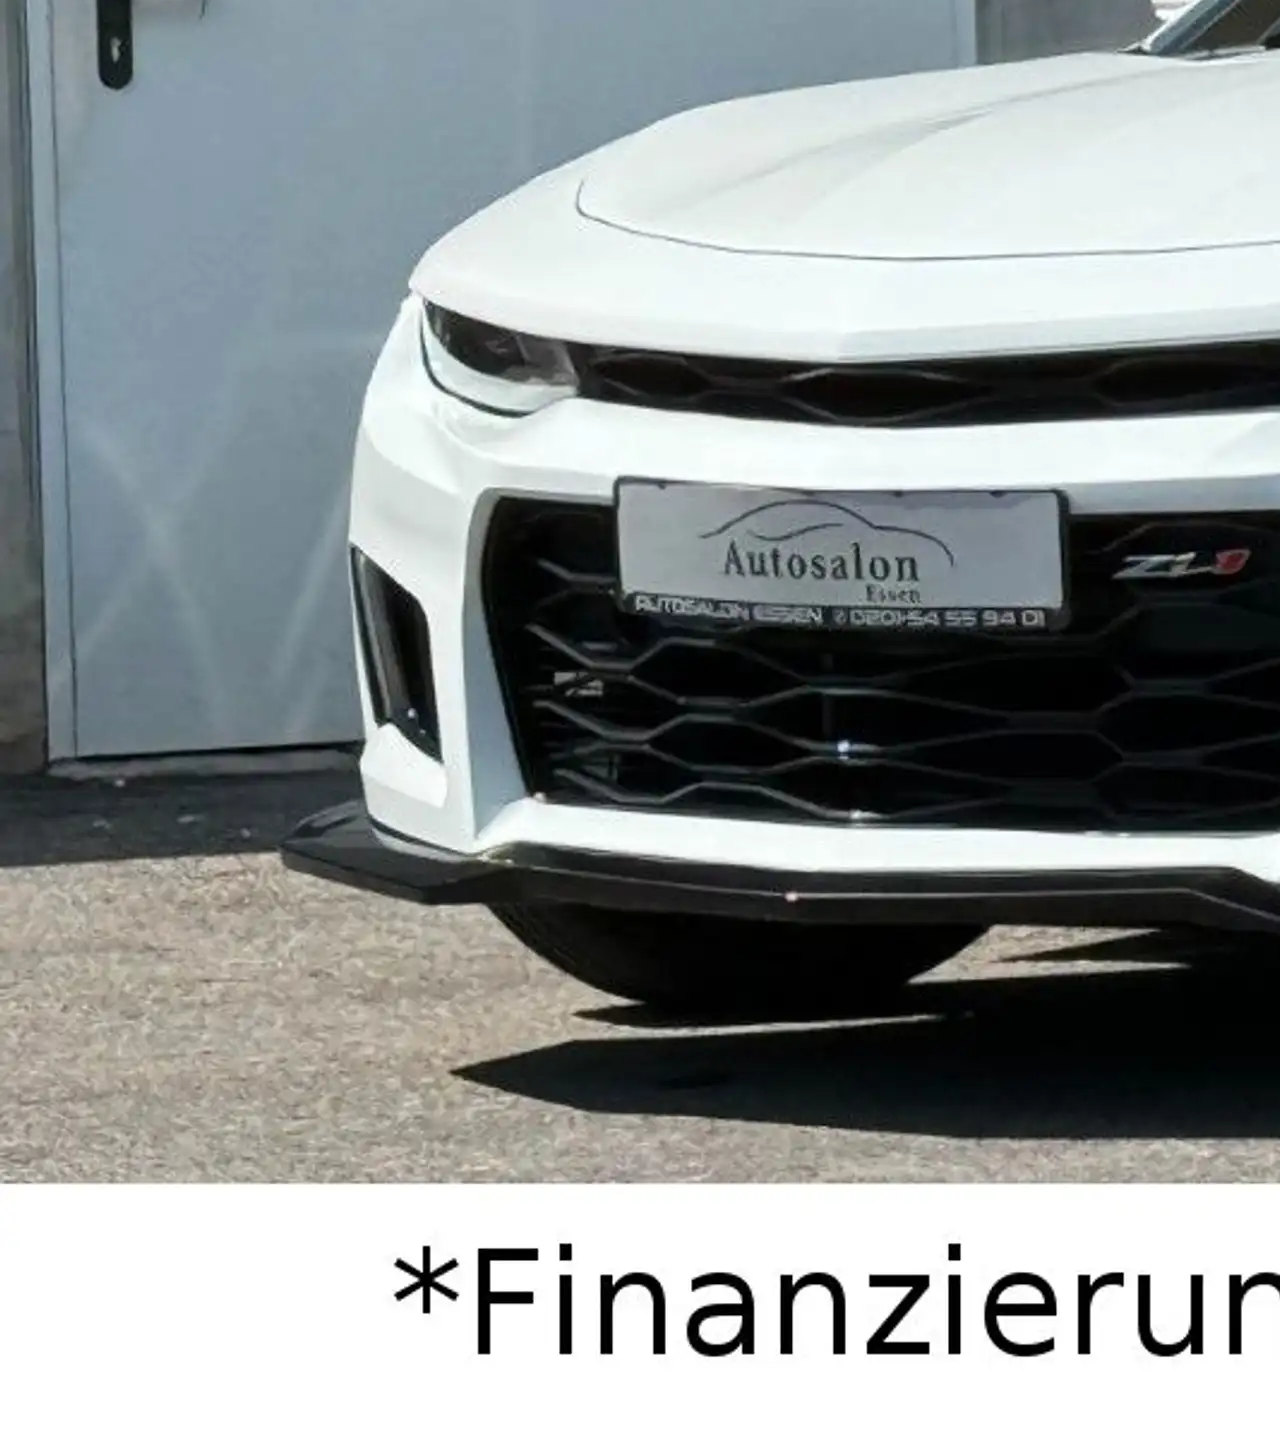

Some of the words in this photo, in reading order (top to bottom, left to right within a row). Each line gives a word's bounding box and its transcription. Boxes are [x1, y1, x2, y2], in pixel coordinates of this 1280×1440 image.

[722, 539, 919, 582] Autosalon
[1110, 548, 1252, 581] ZL1
[634, 594, 749, 622] AUTOSALON
[752, 603, 824, 626] ESSEN
[865, 584, 921, 604] Essen
